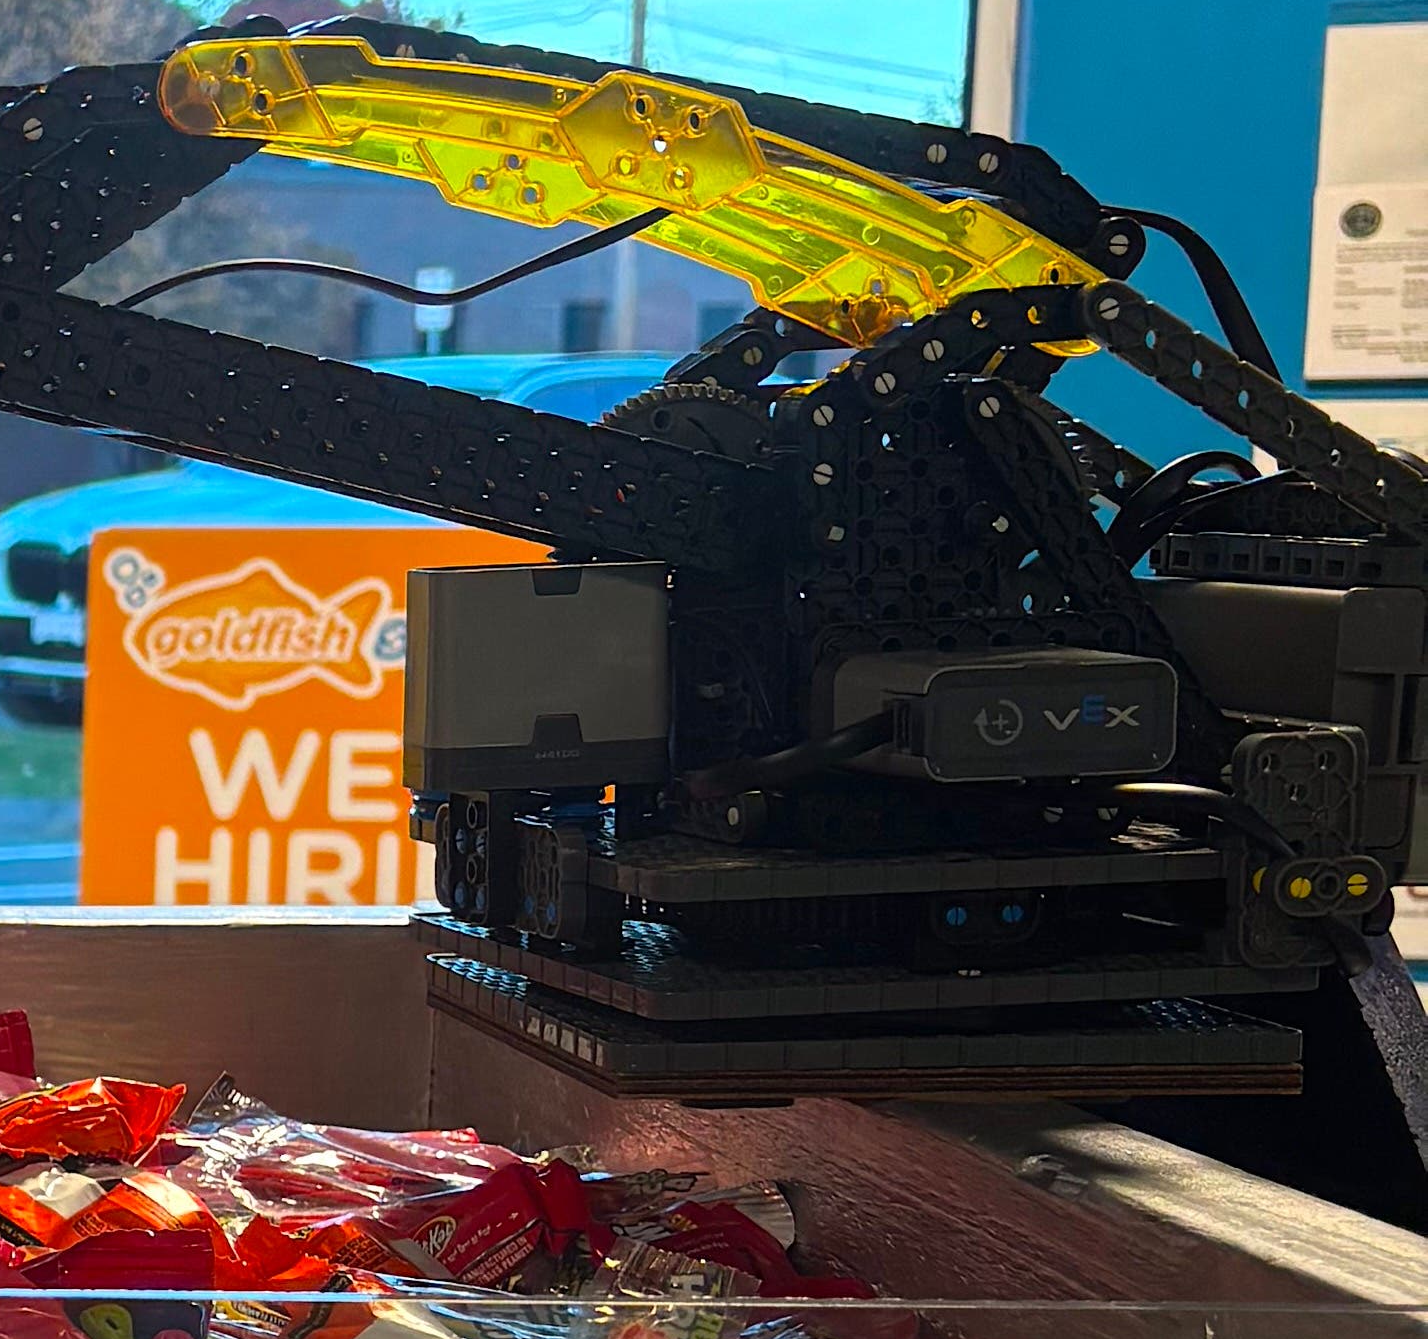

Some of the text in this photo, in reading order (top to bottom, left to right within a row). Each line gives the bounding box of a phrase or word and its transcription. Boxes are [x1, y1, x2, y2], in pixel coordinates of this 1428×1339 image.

[148, 610, 356, 667] goldfish
[1044, 695, 1141, 732] VEX
[154, 828, 435, 906] HIRI
